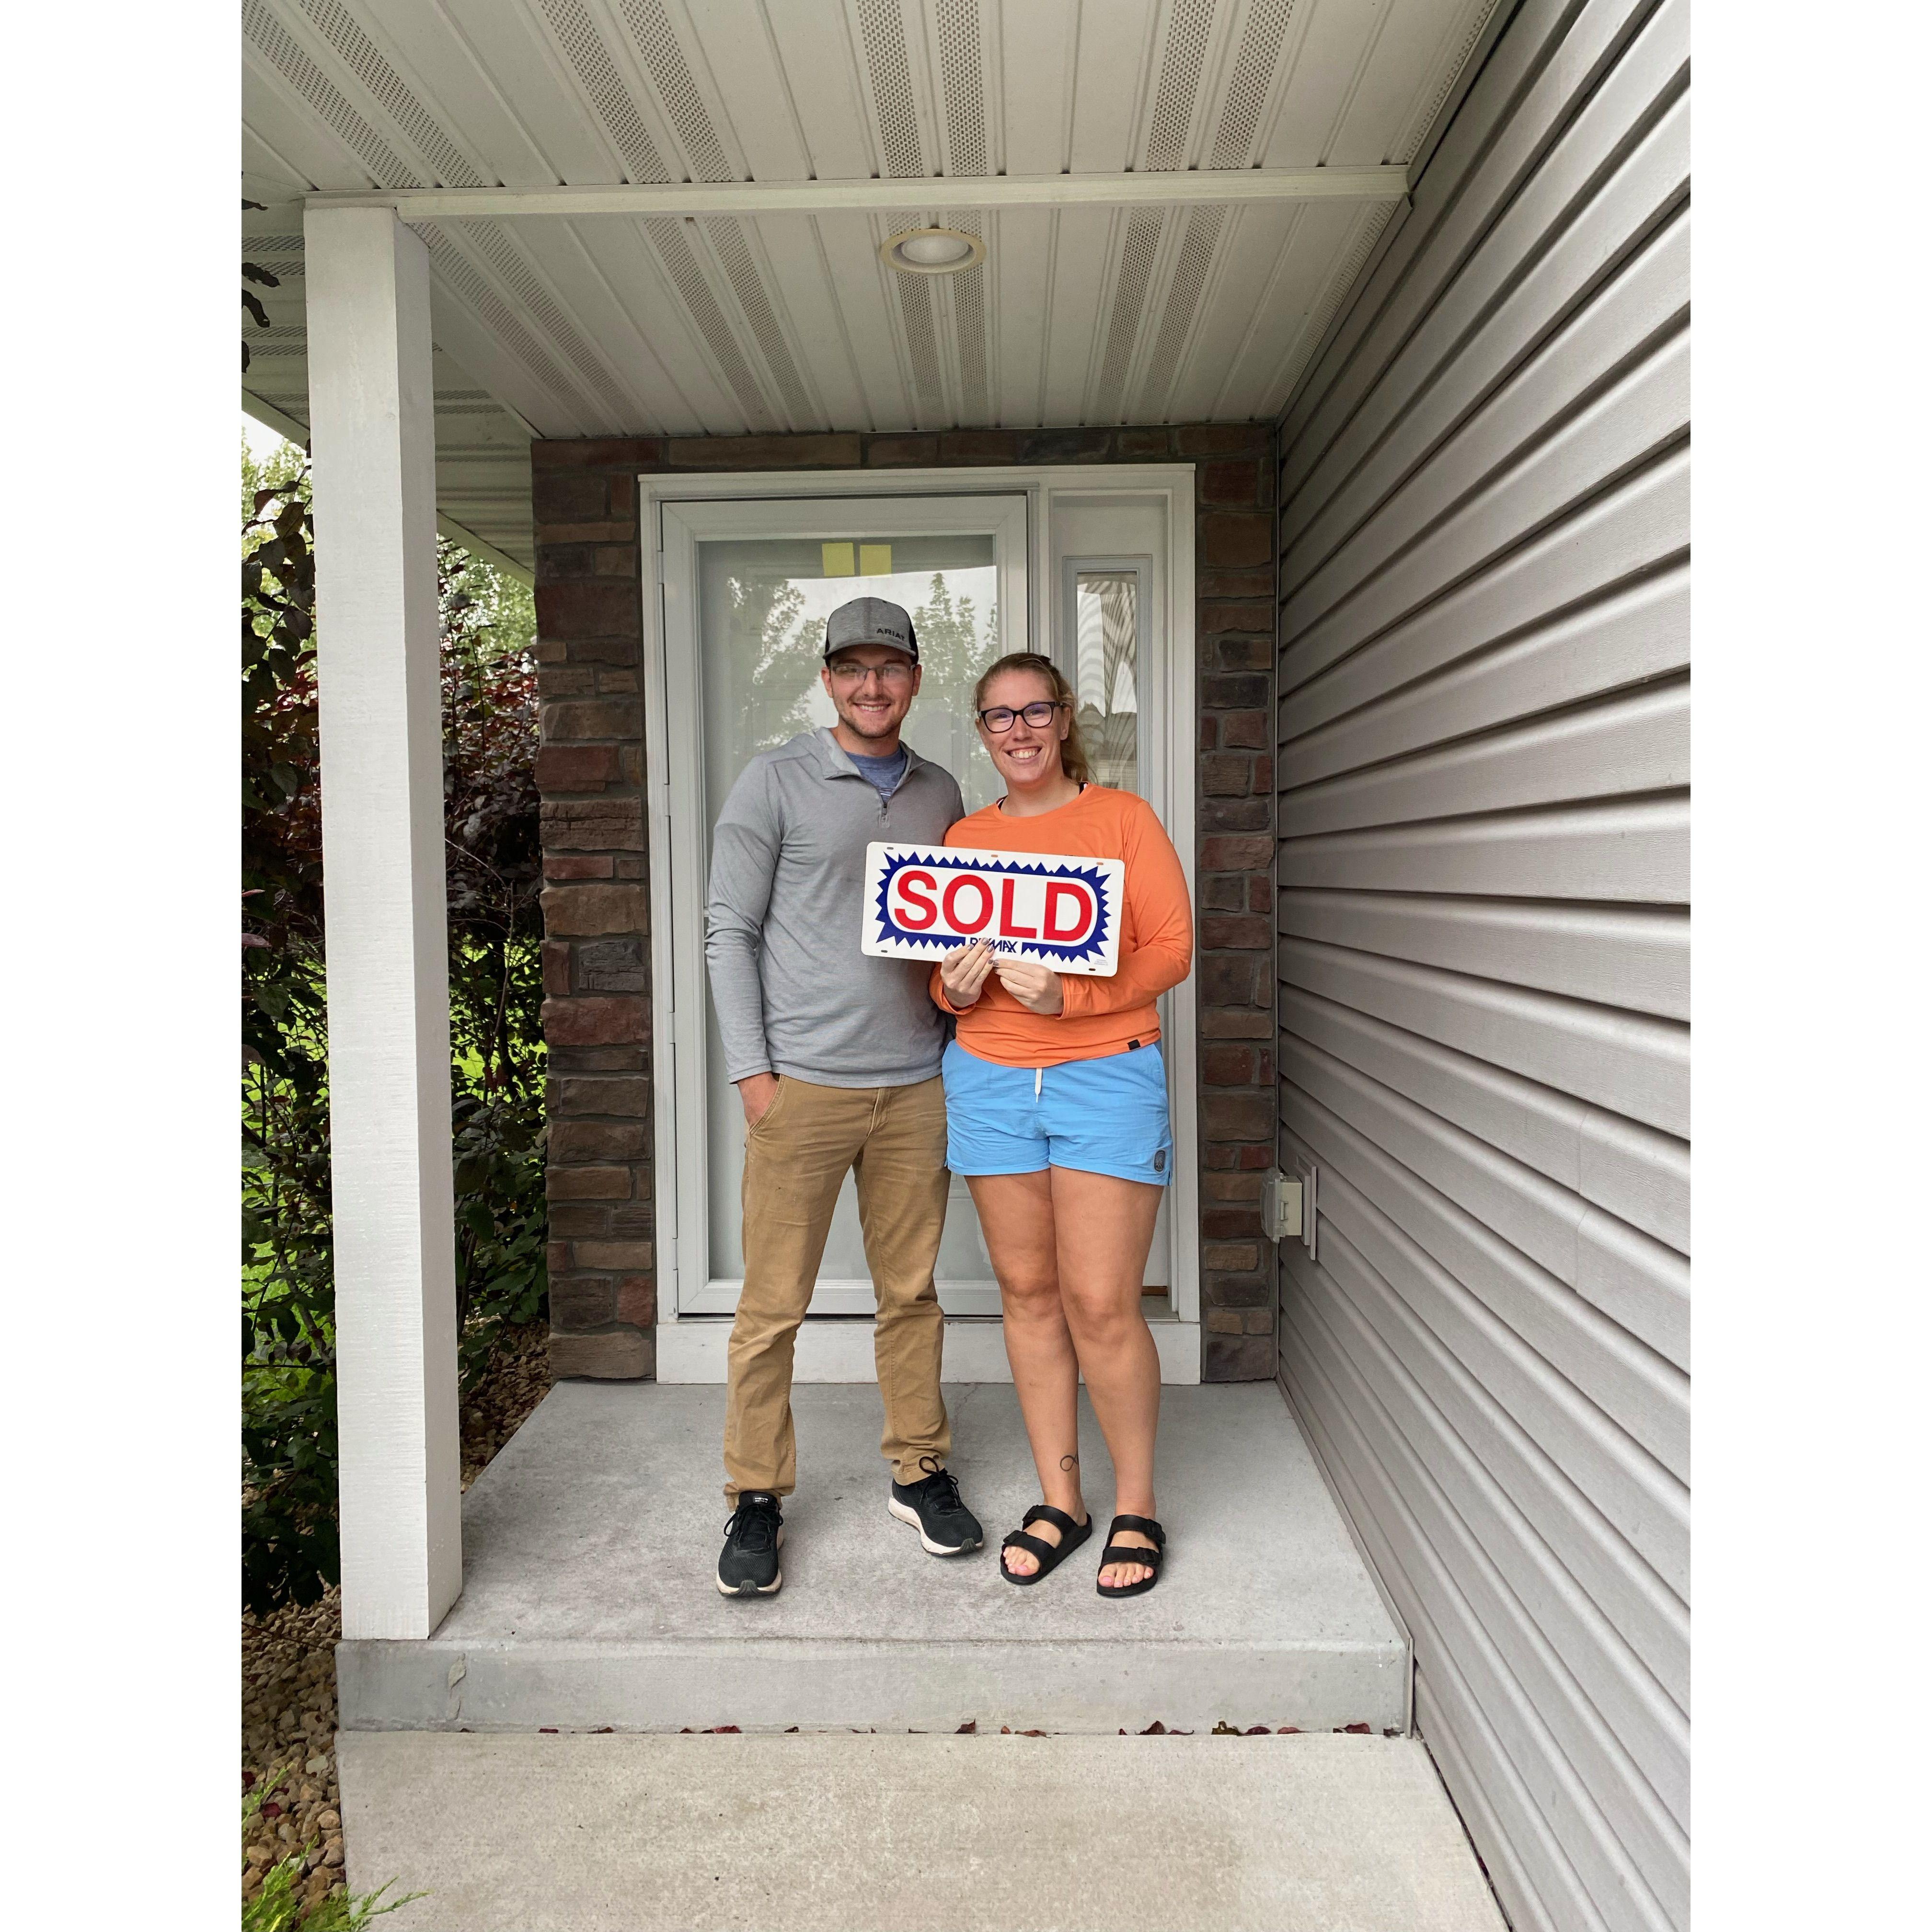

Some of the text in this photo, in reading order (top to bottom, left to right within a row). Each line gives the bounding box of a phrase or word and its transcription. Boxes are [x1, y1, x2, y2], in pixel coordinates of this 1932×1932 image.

[876, 628, 905, 641] ARIAT
[894, 870, 1092, 942] SOLD
[970, 937, 1018, 953] RMAX
